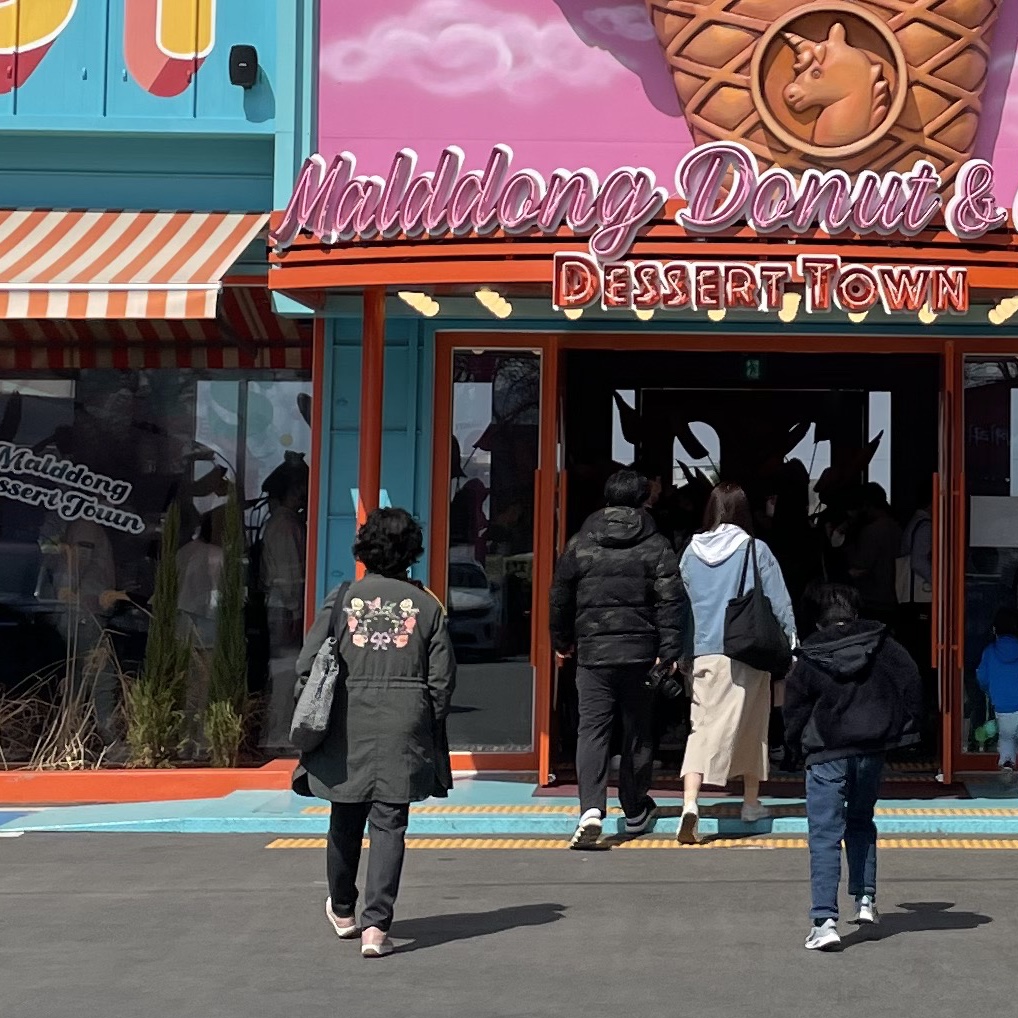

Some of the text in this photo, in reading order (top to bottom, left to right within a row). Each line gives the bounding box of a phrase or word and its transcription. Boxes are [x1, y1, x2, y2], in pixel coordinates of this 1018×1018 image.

[270, 143, 668, 265] Malddong
[675, 141, 943, 236] Donut
[945, 158, 1008, 239] &
[552, 251, 970, 315] DESSERT TOWN
[0, 441, 133, 505] Malddong
[58, 491, 146, 534] Town
